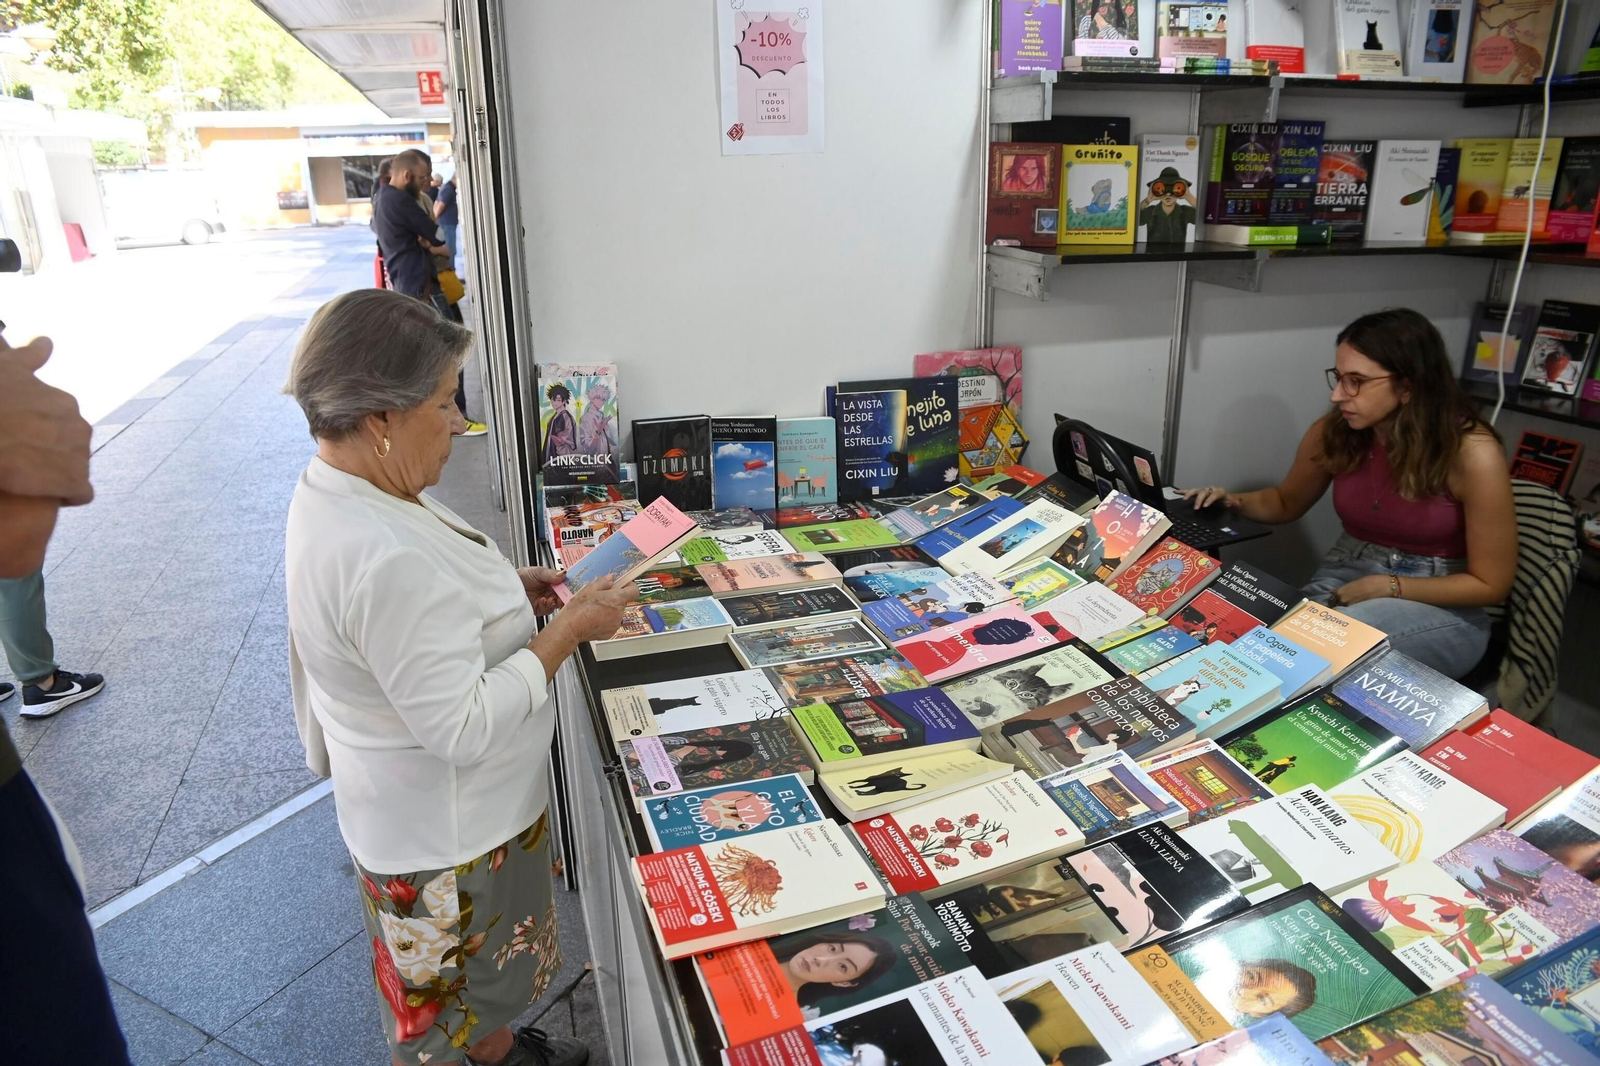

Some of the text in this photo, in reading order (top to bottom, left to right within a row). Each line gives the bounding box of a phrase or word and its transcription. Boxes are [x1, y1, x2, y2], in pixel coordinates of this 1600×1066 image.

[751, 31, 792, 47] -10%
[1231, 123, 1278, 134] CIXIN LIU
[1304, 126, 1321, 135] LIU
[1075, 148, 1122, 160] Gruñito
[1231, 152, 1270, 162] BOSQUE
[1322, 144, 1373, 153] CIXIN LIU
[1234, 164, 1265, 172] OSCURO
[1314, 196, 1366, 206] ERRANTE
[1316, 183, 1368, 195] TIERRA
[843, 400, 883, 410] LA VISTA
[844, 413, 873, 422] DESDE
[844, 426, 861, 434] LAS
[844, 436, 893, 447] ESTRELLAS
[550, 454, 612, 466] LINK CLICK
[642, 455, 705, 475] UZUMAKI
[845, 467, 899, 480] CIXIN LIU
[646, 505, 673, 528] DORAYAKI
[561, 528, 594, 540] NARUTO
[755, 532, 785, 553] ESPERA
[978, 576, 996, 590] tardes
[1217, 577, 1256, 602] DEL PROFESOR
[1232, 574, 1257, 592] FÓRMULA
[1256, 588, 1288, 610] PREFERIDA
[1298, 612, 1347, 637] La república
[1307, 605, 1349, 628] Ito Ogawa
[944, 626, 988, 663] almendra
[1156, 638, 1174, 650] GATO
[1253, 629, 1297, 657] Ito Ogawa
[1290, 618, 1346, 648] de la felicidad
[1119, 652, 1141, 668] LIBROS
[1133, 651, 1146, 660] LOS
[1149, 643, 1164, 653] QUE
[1234, 643, 1267, 665] Tsubaki
[1243, 636, 1295, 668] La papelería
[1198, 668, 1228, 690] difíciles
[1219, 657, 1247, 679] Un gato
[1370, 665, 1384, 676] LOS
[1384, 671, 1440, 707] MILAGROS
[1116, 677, 1180, 732] La biblioteca
[1355, 673, 1438, 727] NAMIYA
[1086, 689, 1138, 738] comienzos
[1101, 684, 1169, 743] de los nuevos
[1295, 720, 1313, 736] centro
[1313, 732, 1326, 743] del
[1327, 740, 1348, 761] mundo
[1436, 750, 1450, 760] EM
[1163, 768, 1207, 809] Satoshi Yagisawa
[1417, 767, 1446, 790] KANG
[777, 789, 794, 803] EL
[1053, 788, 1073, 811] librería
[1070, 783, 1110, 823] Satoshi Yagisawa
[1300, 789, 1347, 827] HAN KANG
[683, 795, 717, 843] CIUDAD
[741, 812, 761, 831] LA
[755, 791, 786, 827] GATO
[660, 824, 692, 835] BRADLEY
[674, 829, 694, 838] NICK
[1286, 796, 1355, 855] Actos humanos
[885, 825, 908, 857] NATSUME
[1137, 830, 1183, 874] LUNA LLENA
[1150, 825, 1192, 862] Aki Shimazaki
[683, 851, 709, 893] NATSUME
[885, 899, 901, 920] Shin
[899, 918, 912, 934] Por
[907, 931, 928, 962] favor,
[905, 902, 940, 950] Kyung-sook
[934, 903, 972, 953] YOSHIMOTO
[945, 899, 974, 937] BANANA
[1508, 912, 1548, 944] El signo de
[1269, 918, 1326, 976] nacida en 1982
[1281, 914, 1338, 972] Kim Ji-young,
[1297, 907, 1370, 976] Cho Nam-joo
[1148, 951, 1168, 970] 60
[1400, 948, 1436, 982] las ortigas
[1407, 945, 1438, 971] prefiere
[1418, 941, 1456, 974] Hay quien
[1055, 962, 1080, 991] Heaven
[1069, 957, 1134, 1031] Mieko Kawakami
[1173, 979, 1217, 1027] SU NOMBRE ES
[934, 980, 989, 1061] Mieko Kawakami
[1271, 1027, 1298, 1053] Hiro
